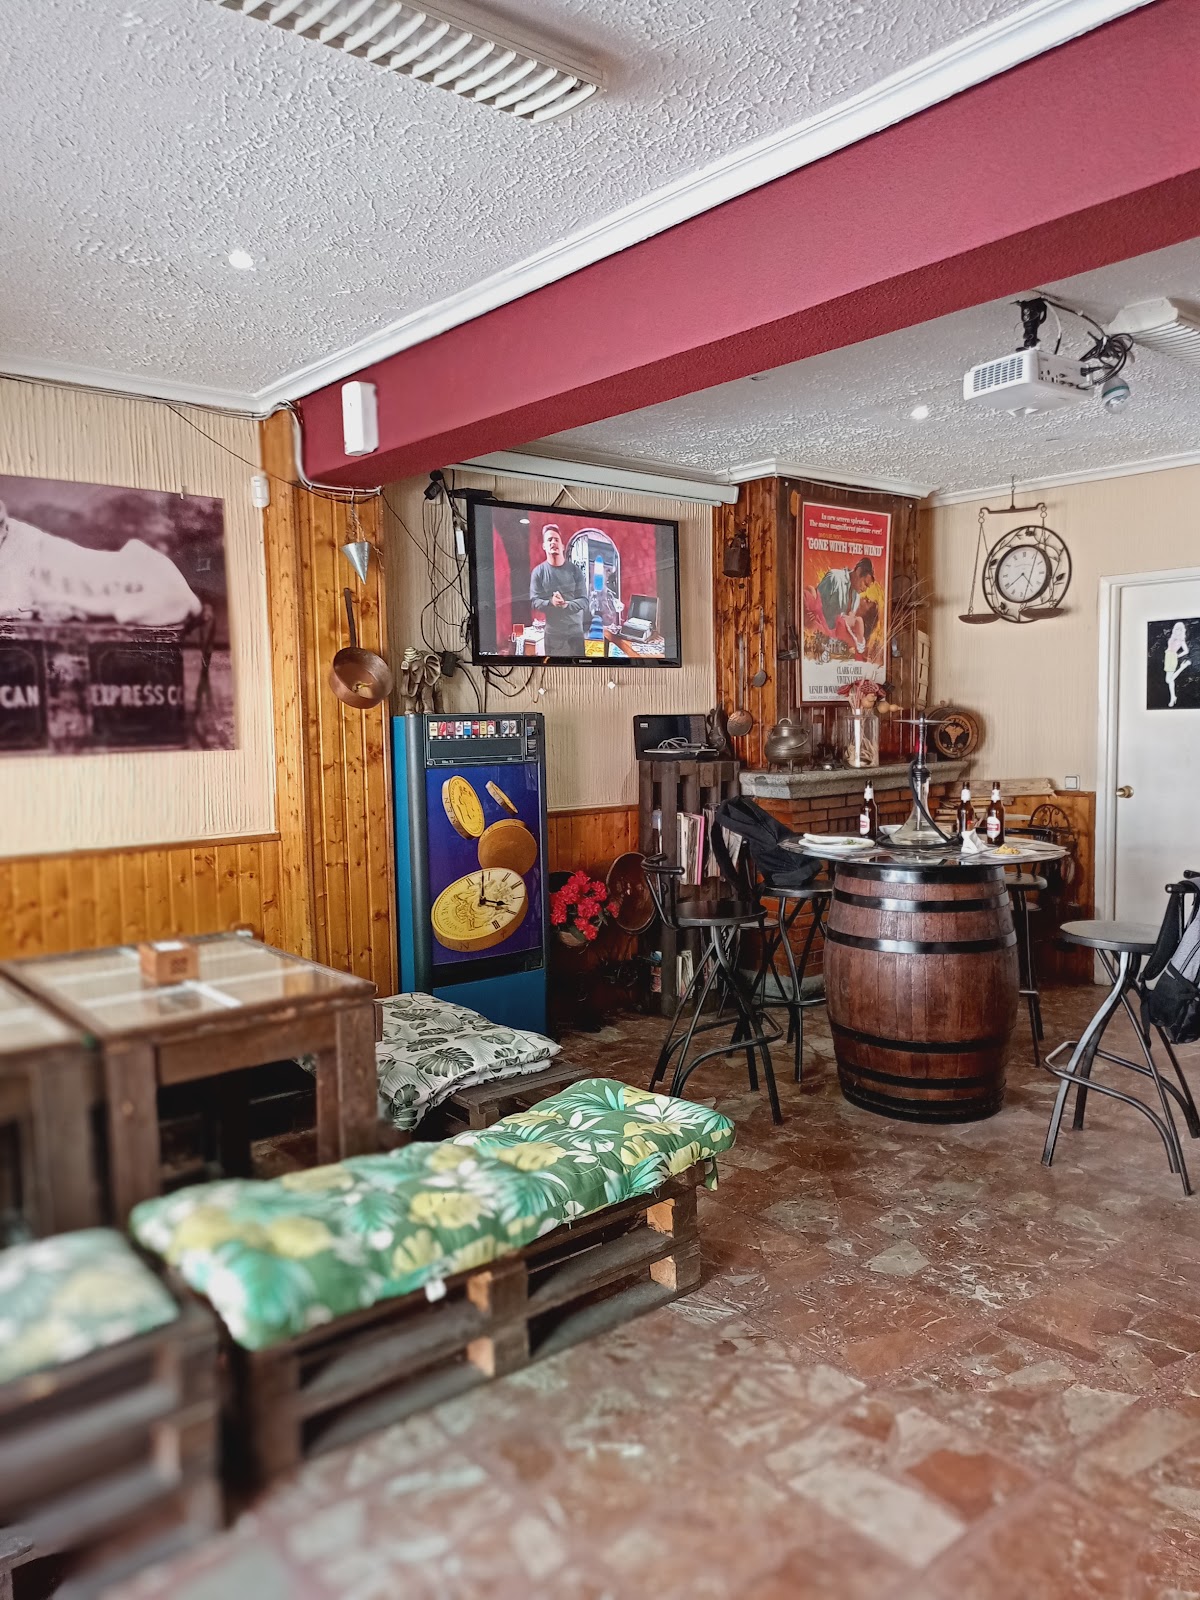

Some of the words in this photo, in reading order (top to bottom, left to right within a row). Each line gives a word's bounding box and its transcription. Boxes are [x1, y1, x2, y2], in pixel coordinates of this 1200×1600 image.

[809, 519, 818, 527] The
[829, 540, 848, 553] WITH
[848, 542, 863, 555] THE
[836, 667, 849, 675] CLARK
[809, 686, 823, 694] LESLIE
[0, 685, 39, 708] CAN
[91, 684, 164, 706] EXPRESS
